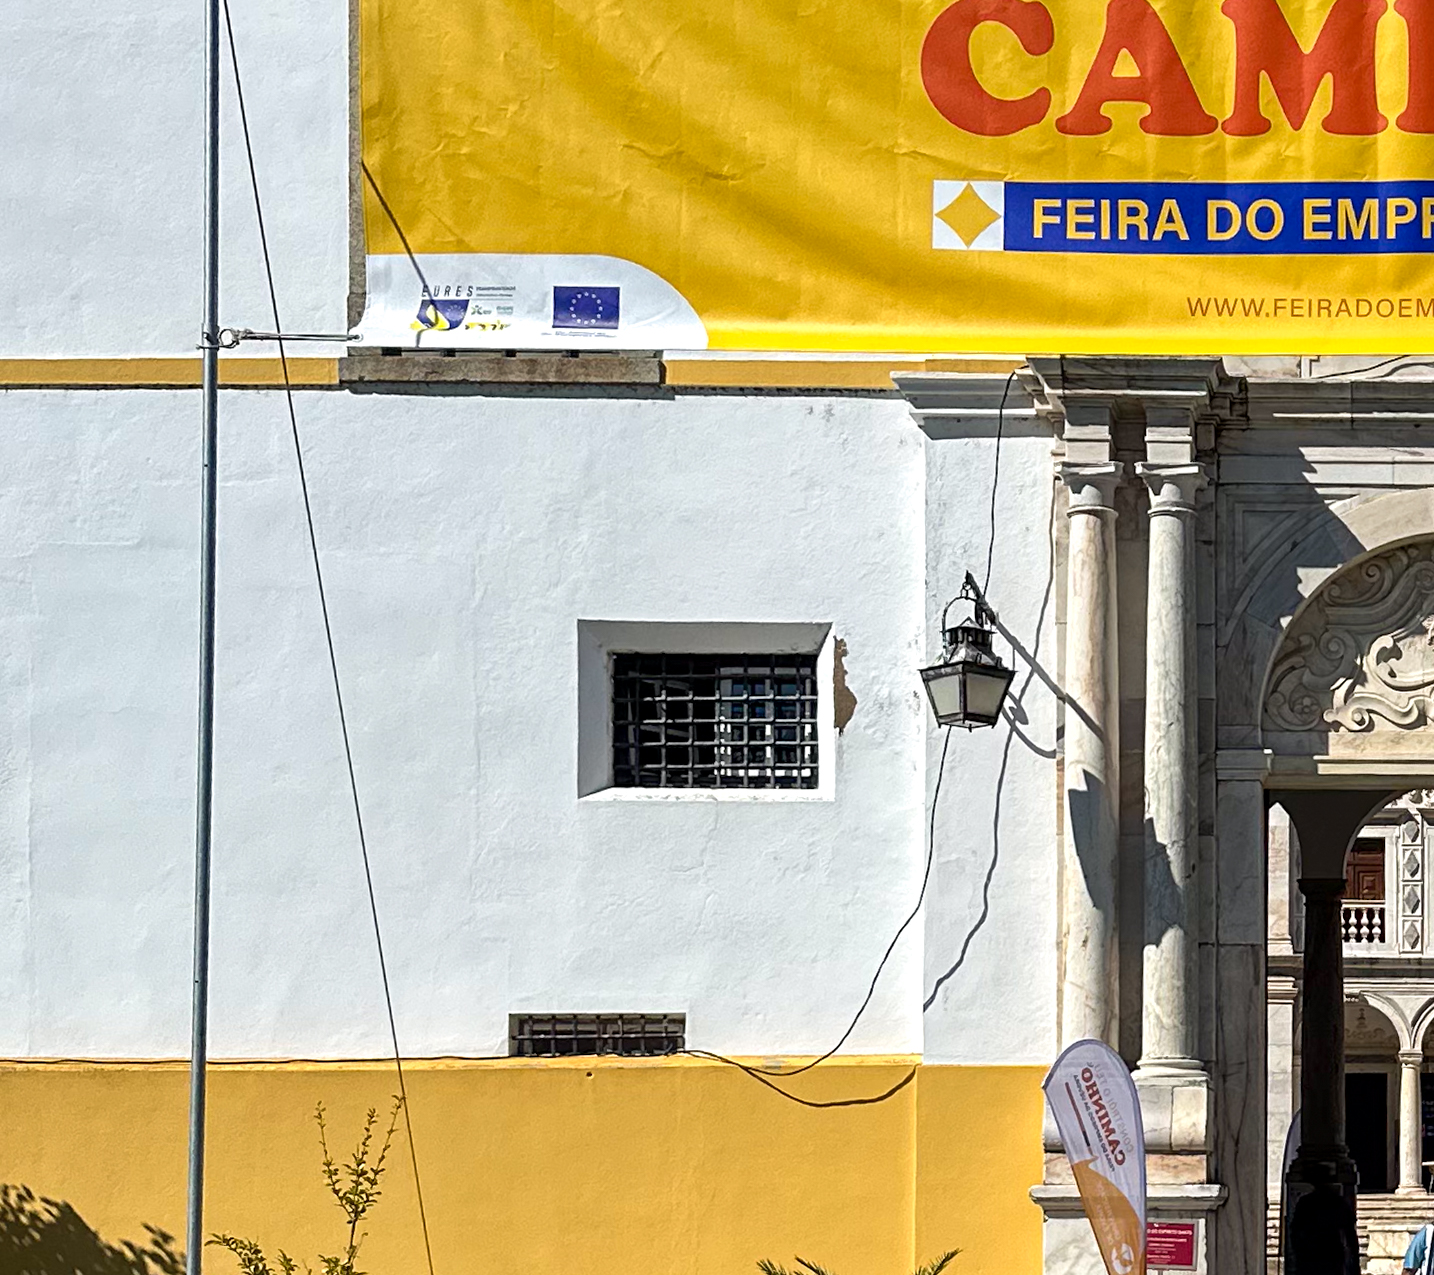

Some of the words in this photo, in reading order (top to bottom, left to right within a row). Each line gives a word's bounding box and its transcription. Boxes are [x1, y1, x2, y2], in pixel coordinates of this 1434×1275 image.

[1032, 197, 1189, 242] FEIRA
[1206, 198, 1285, 241] DO
[421, 285, 474, 298] EURES
